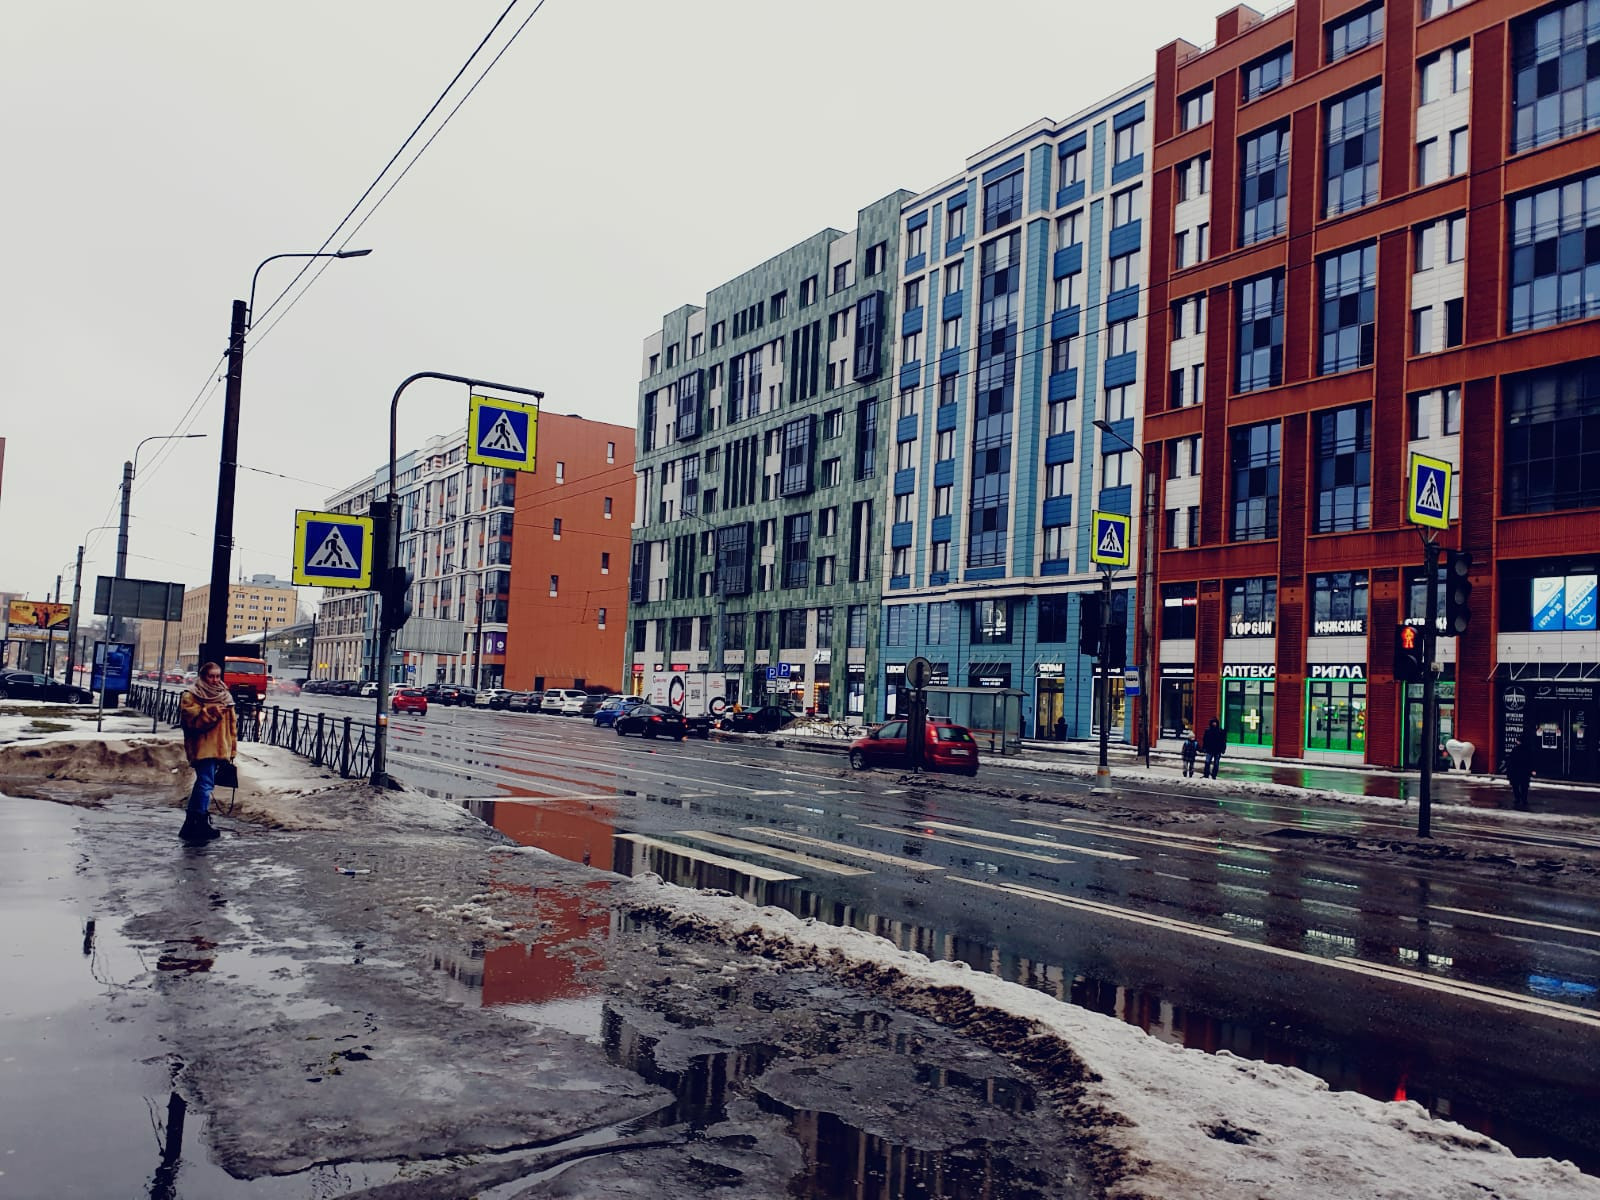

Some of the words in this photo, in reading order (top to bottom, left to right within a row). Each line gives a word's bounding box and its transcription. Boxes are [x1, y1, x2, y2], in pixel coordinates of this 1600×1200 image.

[1231, 622, 1272, 635] TOPGUN
[1315, 620, 1363, 633] МУЖСКИЕ
[1223, 665, 1276, 678] АПТЕКА
[1312, 665, 1363, 678] РИГЛА
